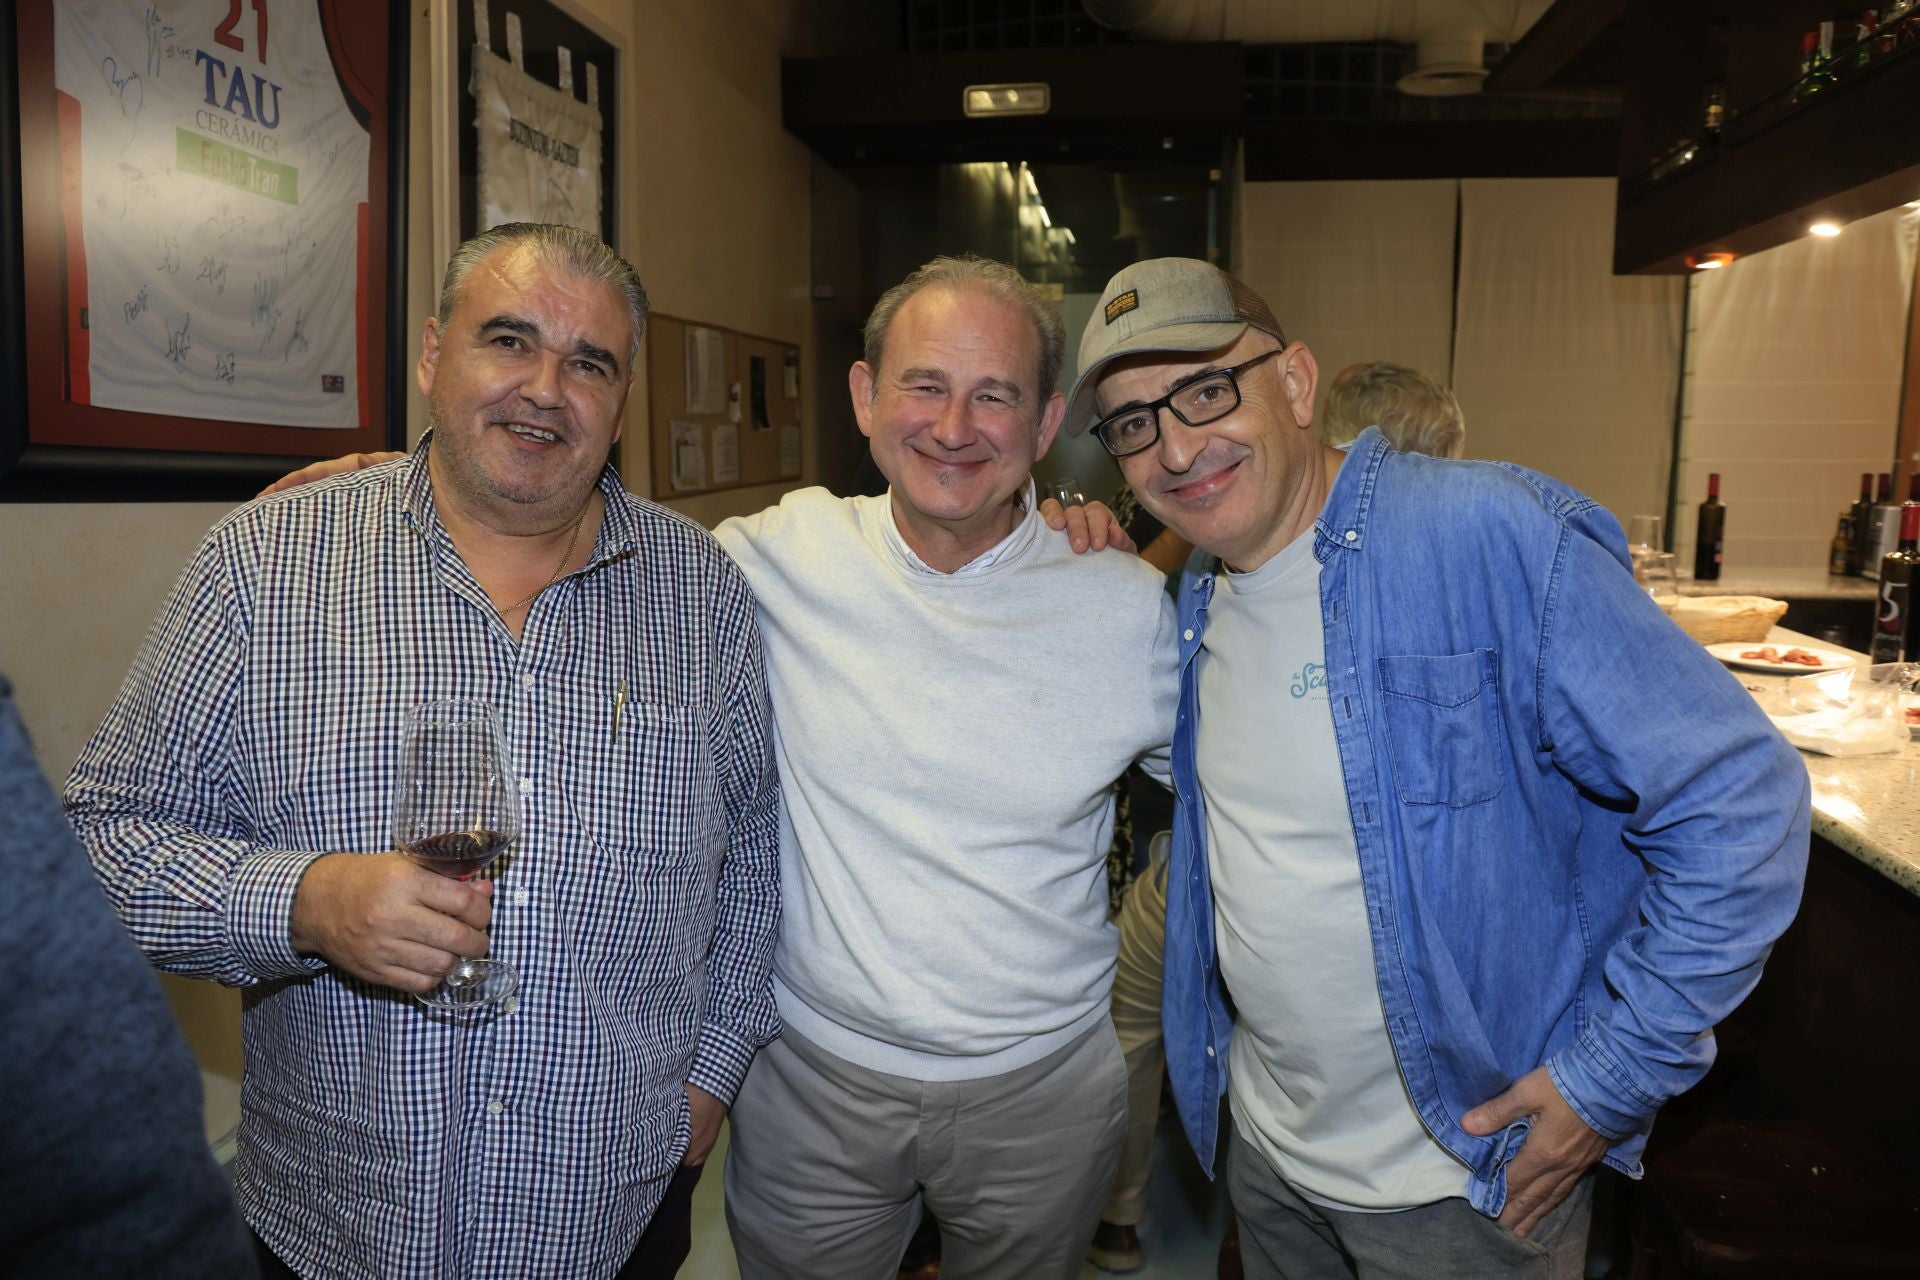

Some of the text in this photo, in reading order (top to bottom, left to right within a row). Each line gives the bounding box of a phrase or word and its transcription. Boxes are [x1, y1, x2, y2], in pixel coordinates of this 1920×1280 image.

[213, 0, 268, 65] 21
[195, 48, 282, 130] TAU
[195, 109, 279, 157] CERÁMICA
[200, 140, 280, 196] EuskoTran
